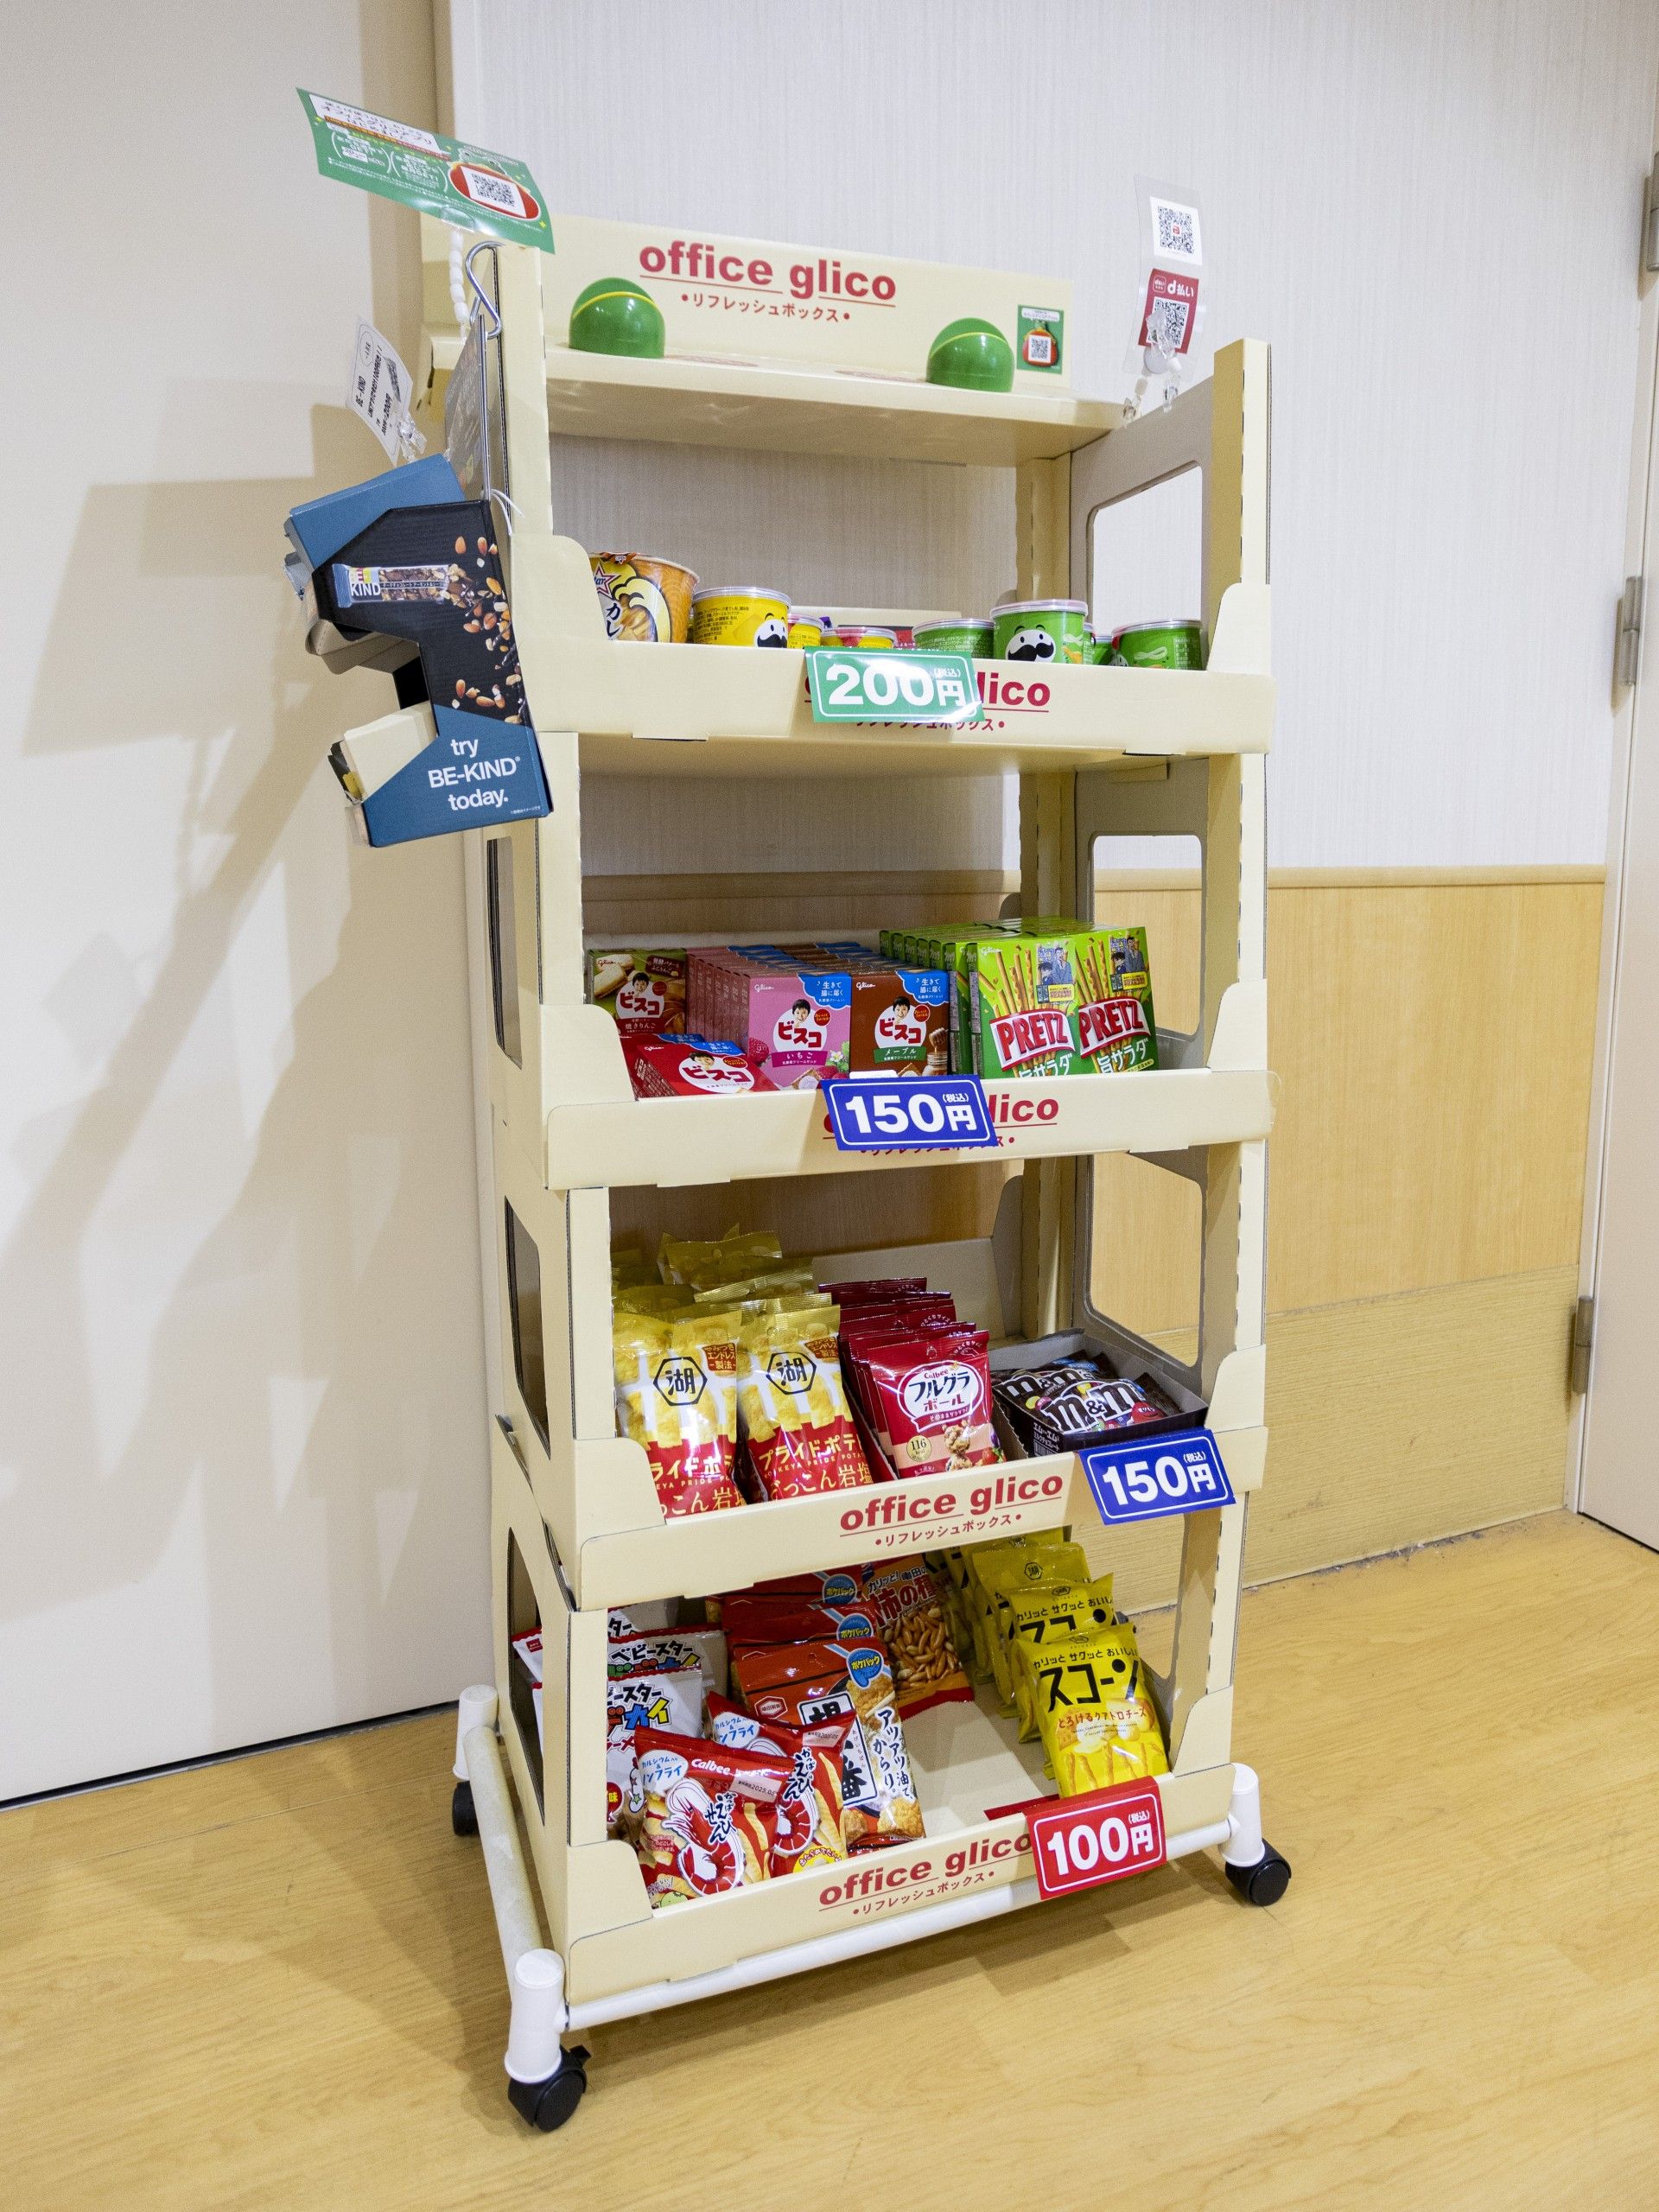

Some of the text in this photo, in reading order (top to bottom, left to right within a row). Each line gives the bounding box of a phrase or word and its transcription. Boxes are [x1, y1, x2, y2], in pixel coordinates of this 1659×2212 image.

[640, 240, 896, 300] office glico
[1167, 279, 1194, 297] d払い
[693, 294, 839, 322] リフレッシュボックス
[350, 583, 381, 596] KIND
[606, 602, 621, 637] カレ
[826, 660, 967, 707] 200円
[976, 671, 1051, 708] lico
[450, 739, 479, 758] try
[448, 788, 509, 810] today.
[753, 984, 775, 993] Glico
[855, 982, 876, 990] Glico
[620, 991, 660, 1015] ビスコ
[778, 1020, 822, 1048] ビスコ
[879, 1017, 921, 1044] ビスコ
[996, 1013, 1069, 1061] PRETZ
[1078, 1000, 1144, 1049] PRETZ
[682, 1065, 752, 1083] ビスコ
[845, 1093, 978, 1134] 150円
[988, 1093, 1059, 1123] lico
[664, 1368, 696, 1395] 湖
[775, 1357, 807, 1387] 湖
[924, 1369, 949, 1380] Calbee
[908, 1370, 970, 1402] フルグラ
[924, 1394, 965, 1414] ボール
[1043, 1382, 1141, 1433] m&m
[759, 1433, 862, 1471] プライドポテ
[911, 1438, 927, 1451] 116
[807, 1457, 836, 1466] PRIDE
[681, 1478, 713, 1487] PRIDE
[1102, 1455, 1217, 1505] 150円
[840, 1475, 1064, 1531] office glico
[885, 1513, 1012, 1547] リフレッシュボックス
[1016, 1596, 1113, 1622] カリッと サクッと おいし
[607, 1617, 632, 1637] ター
[611, 1640, 693, 1662] ベビースター
[851, 1655, 880, 1670] ポケパック
[1033, 1654, 1066, 1670] カリッと
[1069, 1649, 1103, 1662] サクッと
[1039, 1658, 1140, 1713] スコーン
[719, 1724, 755, 1745] ンフライ
[691, 1758, 731, 1776] Calbee
[1046, 1816, 1154, 1876] 100円
[819, 1833, 1032, 1905] office glico
[862, 1872, 984, 1916] リフレッシュボックス
